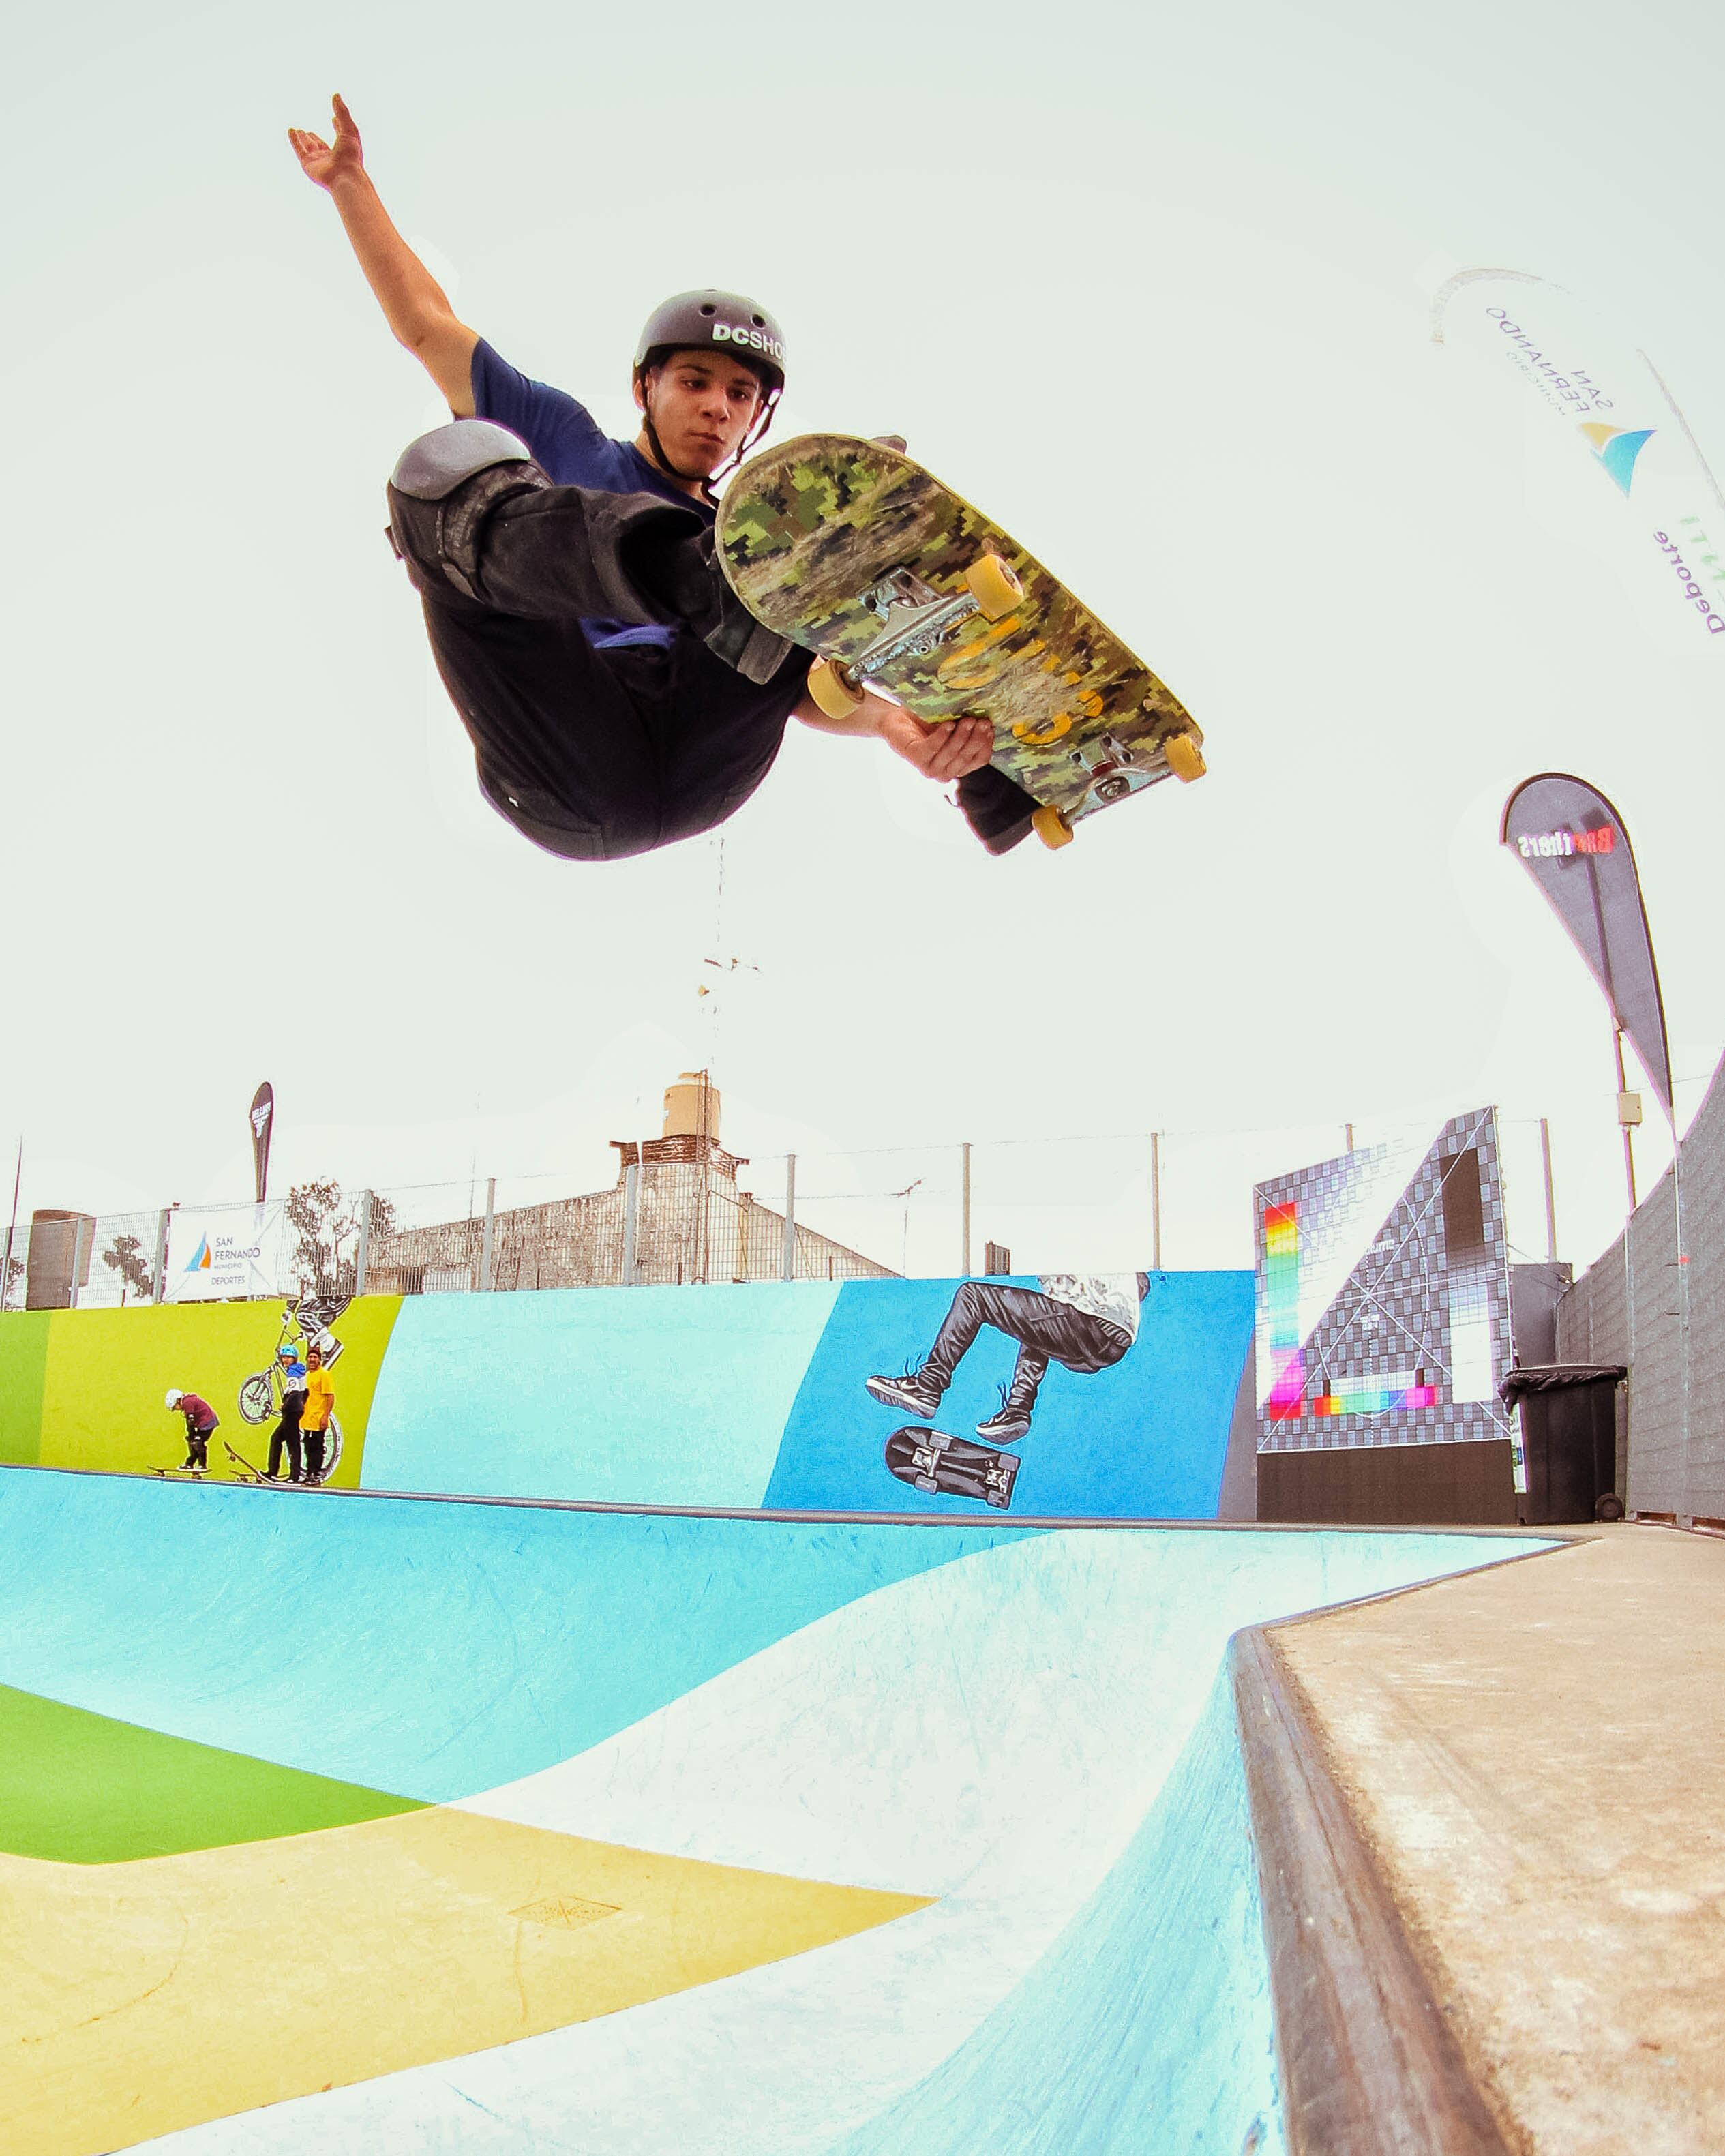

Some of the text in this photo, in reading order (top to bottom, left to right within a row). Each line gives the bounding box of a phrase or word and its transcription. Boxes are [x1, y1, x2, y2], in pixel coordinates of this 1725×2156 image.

[215, 1236, 234, 1247] SAN
[215, 1246, 261, 1261] FERNANDO
[211, 1276, 245, 1285] DEPORTES
